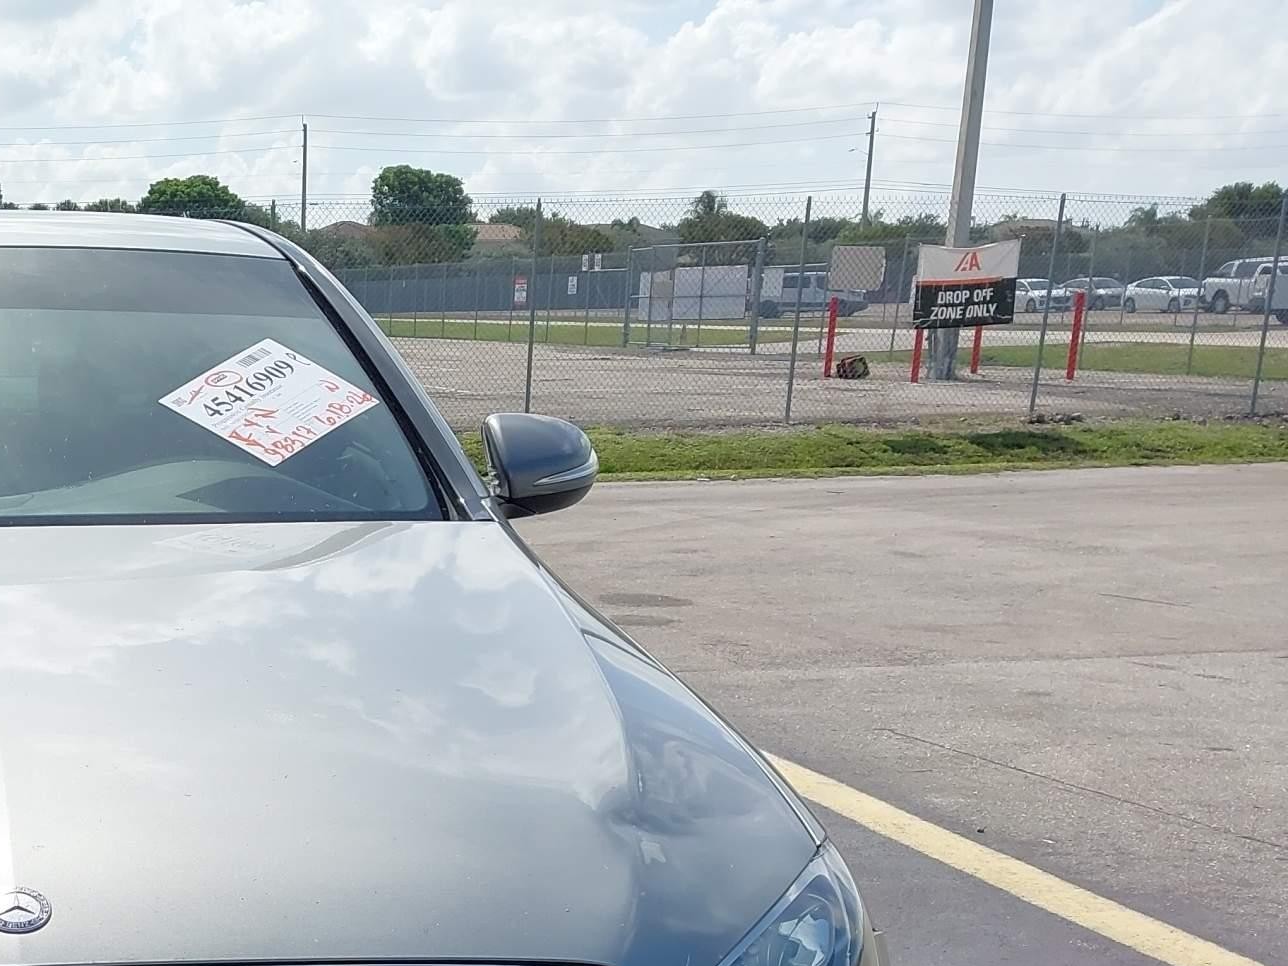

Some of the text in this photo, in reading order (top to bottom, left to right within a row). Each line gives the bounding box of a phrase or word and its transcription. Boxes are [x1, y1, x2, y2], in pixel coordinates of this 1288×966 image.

[937, 287, 994, 304] DROP OFF
[930, 303, 997, 320] ZONE ONLY
[203, 360, 294, 417] 45416909
